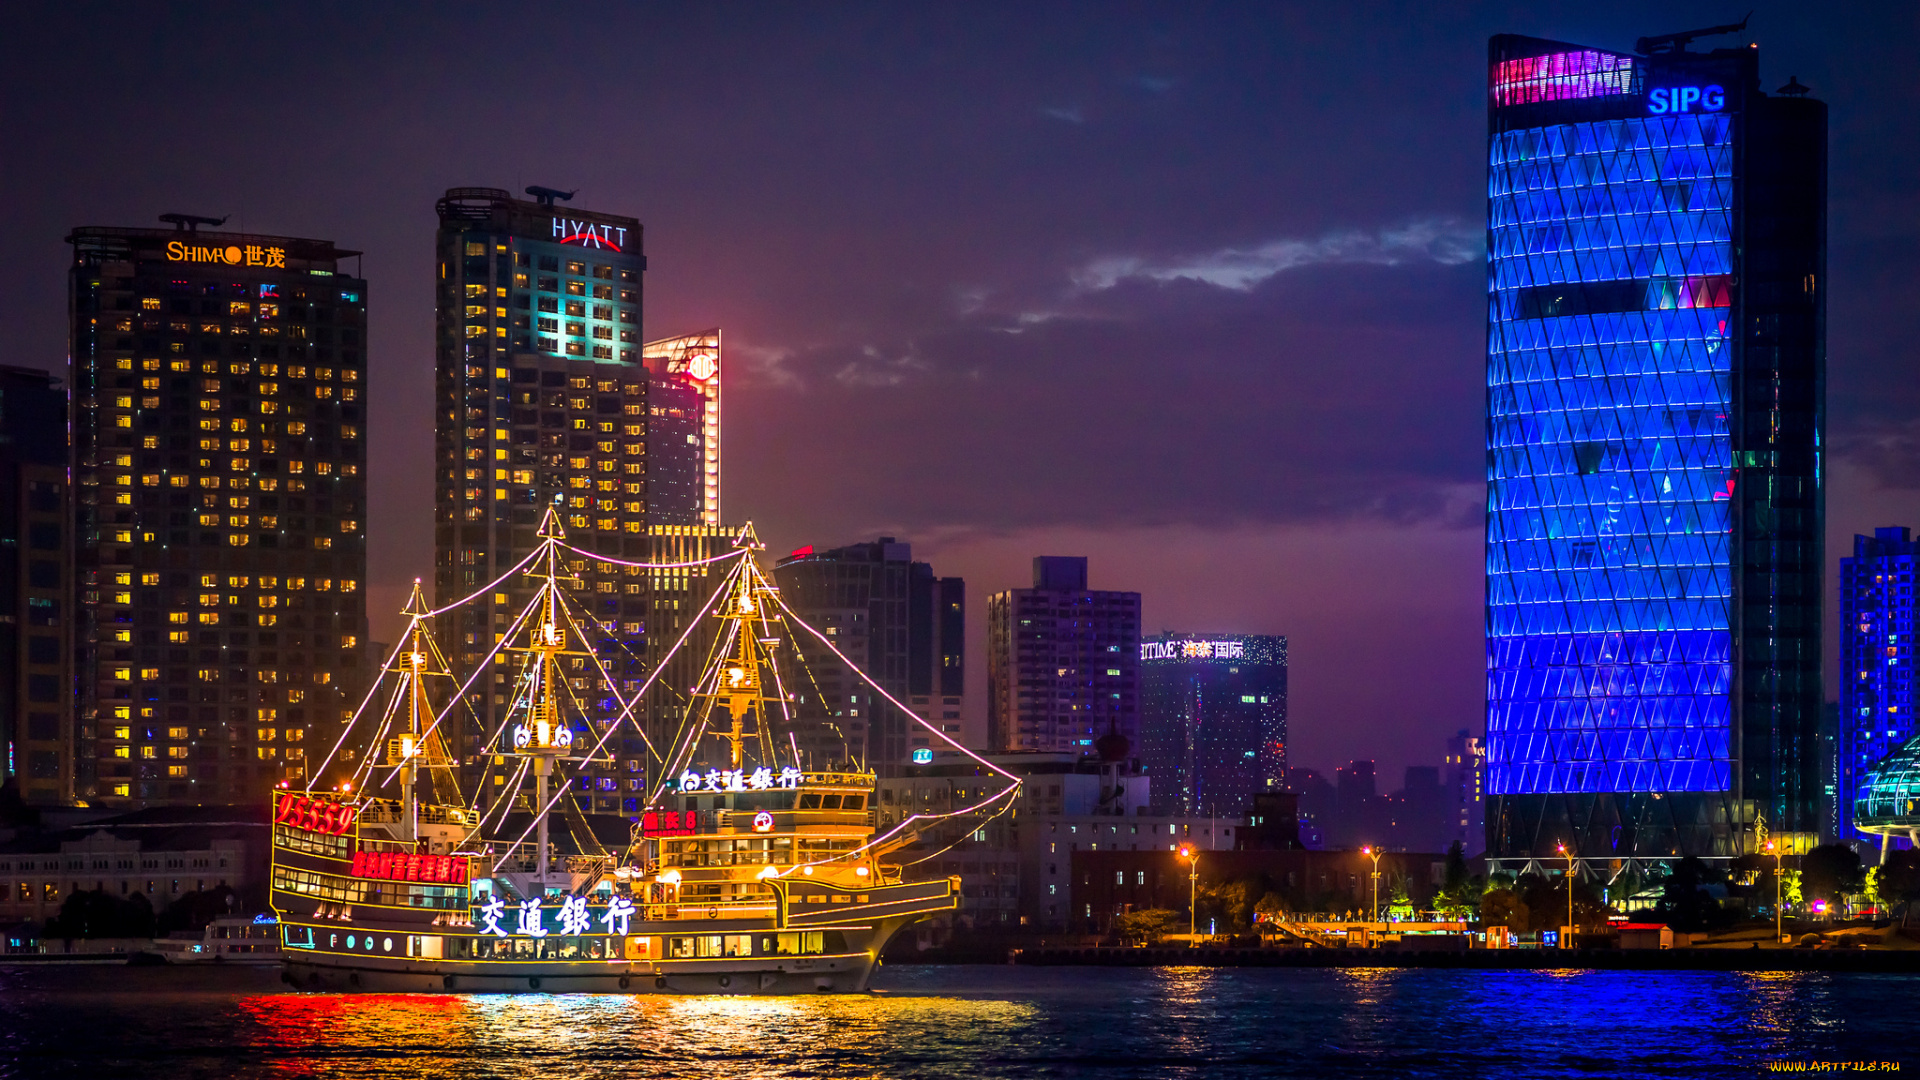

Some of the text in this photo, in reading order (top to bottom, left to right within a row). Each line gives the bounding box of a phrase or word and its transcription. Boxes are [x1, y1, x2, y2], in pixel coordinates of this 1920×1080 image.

[1647, 84, 1725, 114] SIPG
[552, 217, 627, 249] HYATT
[243, 245, 286, 269] 世茂
[275, 793, 354, 836] 95559
[478, 894, 638, 937] 交通銀行
